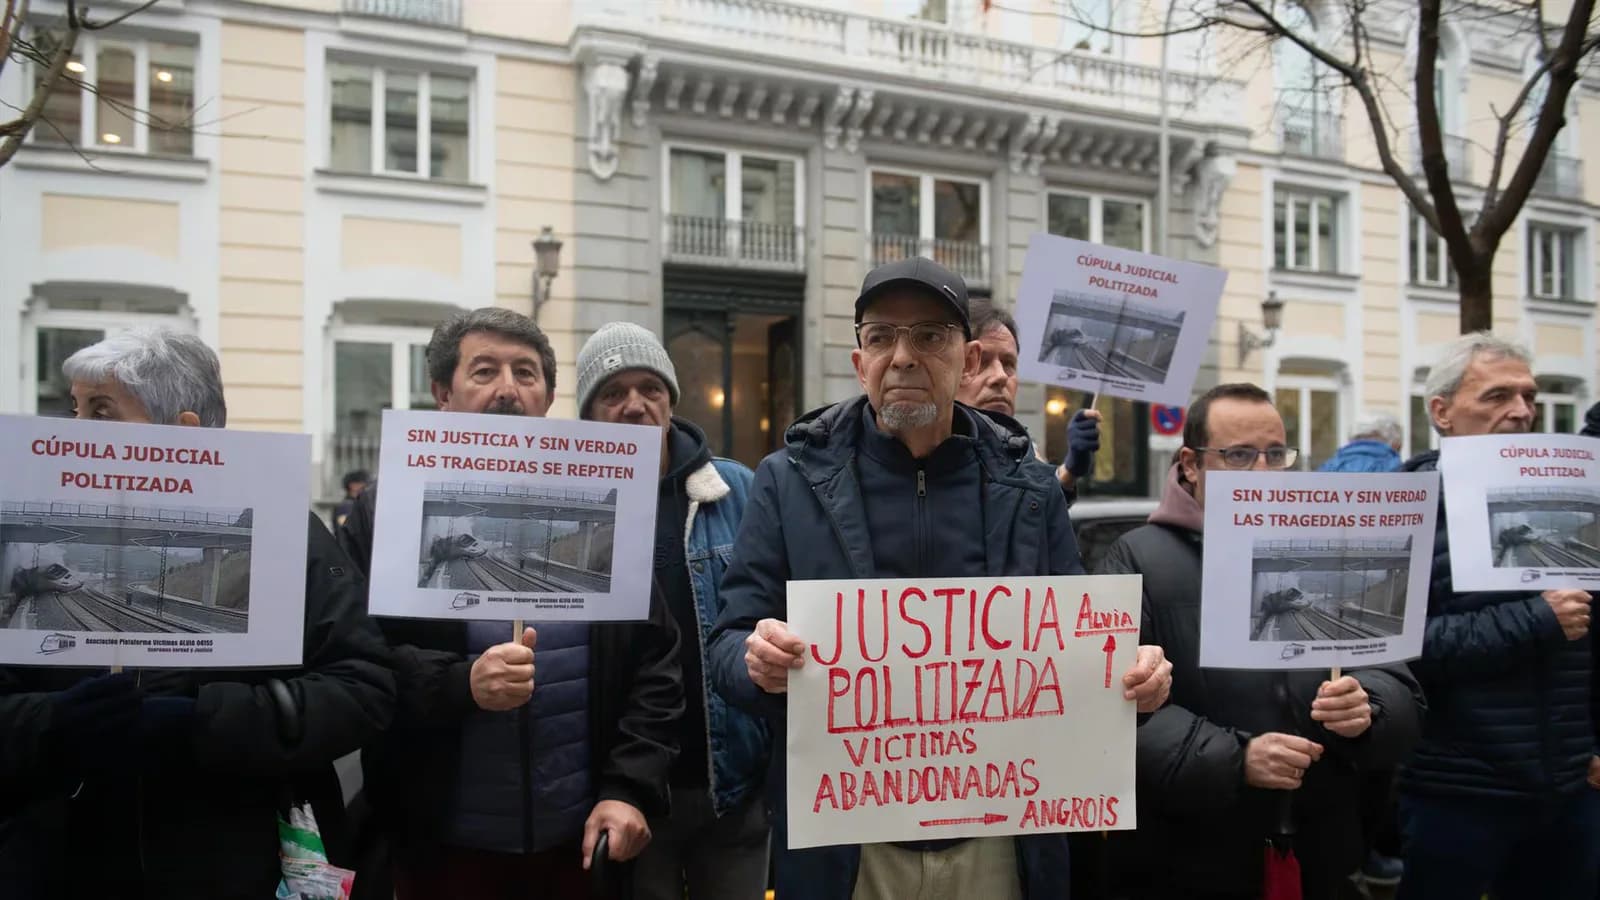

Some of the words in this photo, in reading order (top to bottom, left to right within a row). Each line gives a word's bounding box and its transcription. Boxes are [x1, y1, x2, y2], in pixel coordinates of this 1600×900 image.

[1077, 254, 1122, 273] CÚPULA
[1123, 265, 1179, 284] JUDICIAL
[1089, 276, 1158, 298] POLITIZADA
[31, 435, 116, 460] CÚPULA
[122, 445, 225, 466] JUDICIAL
[407, 429, 436, 442] SIN
[440, 430, 519, 448] JUSTICIA
[524, 436, 535, 448] Y
[539, 436, 570, 451] SIN
[575, 439, 638, 456] VERDAD
[1500, 446, 1549, 459] CÚPULA
[1552, 448, 1596, 461] JUDICIAL
[407, 454, 436, 468] LAS
[441, 456, 538, 474] TRAGEDIAS
[543, 462, 562, 475] SE
[568, 463, 634, 480] REPITEN
[1520, 466, 1586, 478] POLITIZADA
[61, 471, 193, 494] POLITIZADA
[1232, 489, 1262, 503] SIN
[1267, 489, 1340, 503] JUSTICIA
[1344, 490, 1356, 503] Y
[1357, 490, 1382, 503] SIN
[1385, 489, 1427, 503] VERDAD
[1233, 513, 1263, 526] LAS
[1268, 513, 1356, 528] TRAGEDIAS
[1359, 514, 1376, 527] SE
[1379, 512, 1424, 527] REPITEN
[811, 585, 1065, 665] JUSTICIA
[119, 638, 152, 646] Plataforma
[828, 657, 1065, 732] POLITIZADA
[843, 727, 977, 767] VICTIMAS
[813, 758, 1040, 813] ABANDONADAS
